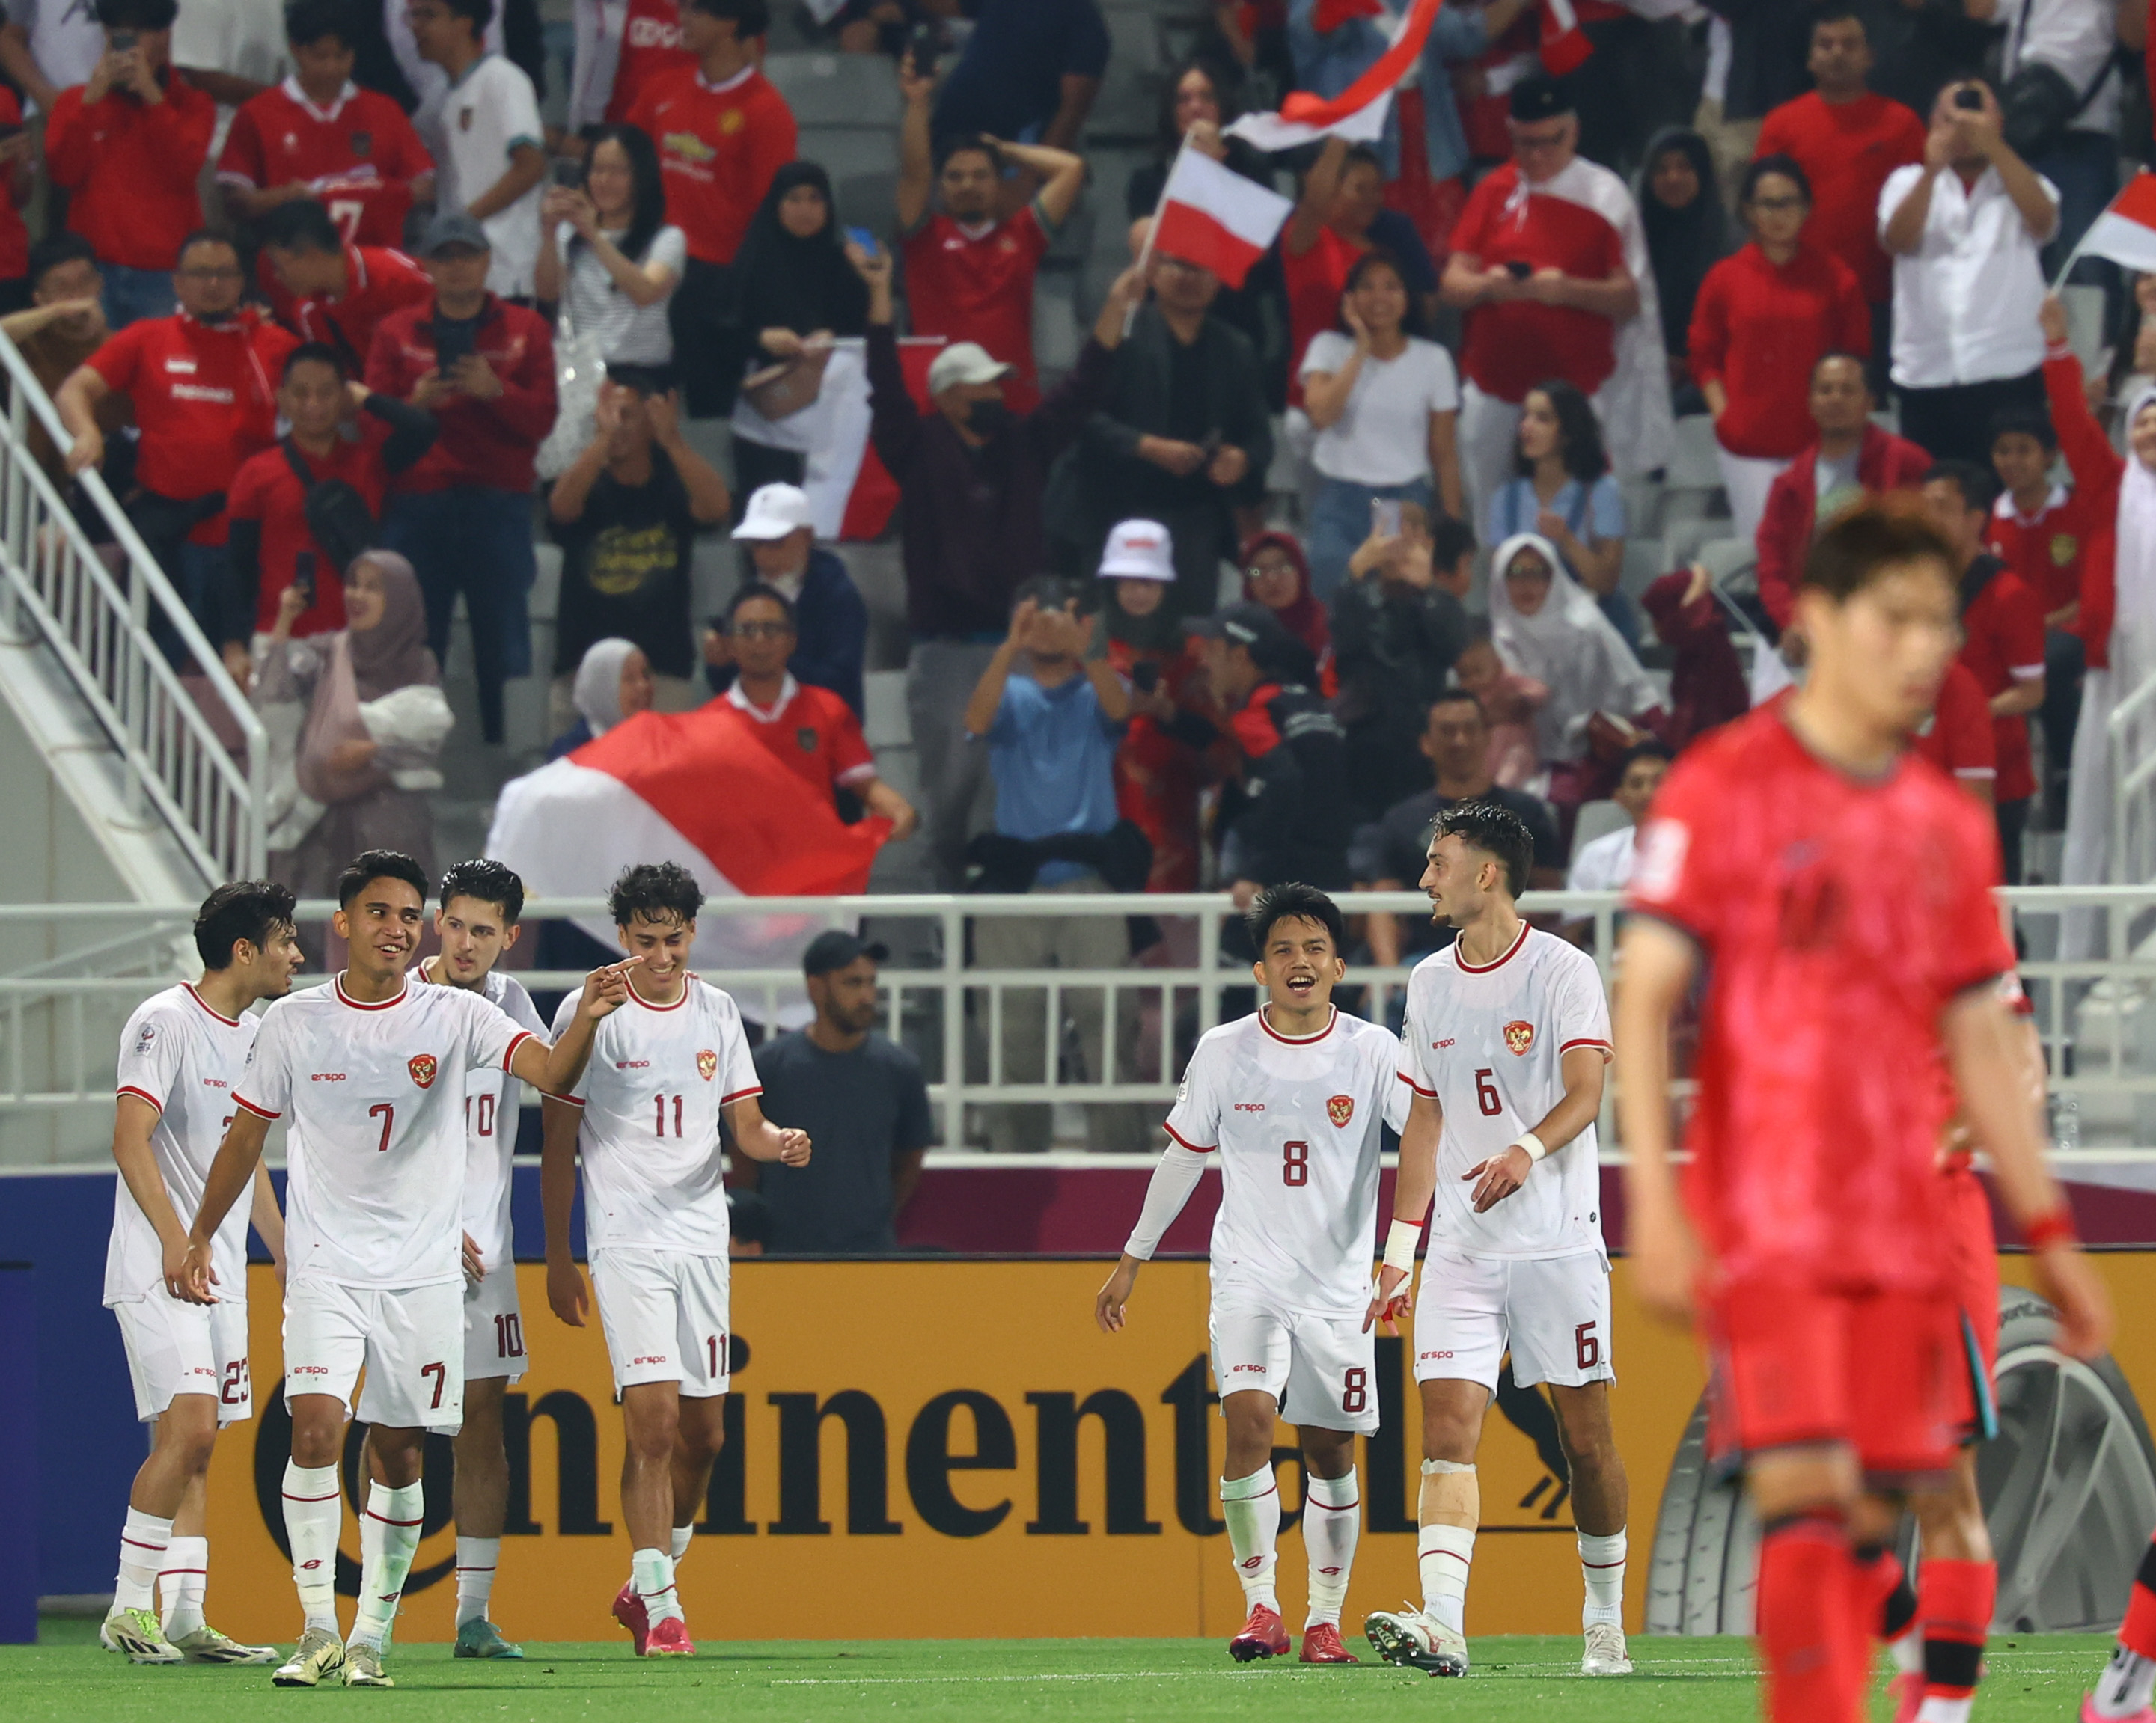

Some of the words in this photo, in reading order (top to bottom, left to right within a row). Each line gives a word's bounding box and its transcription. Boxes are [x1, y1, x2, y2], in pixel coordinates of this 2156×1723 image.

[1432, 1038, 1455, 1050] erspo
[203, 1077, 227, 1089] erspo
[311, 1072, 346, 1083] erspo
[1474, 1068, 1503, 1116] 6
[368, 1102, 394, 1152] 7
[654, 1093, 683, 1138] 11
[1234, 1103, 1265, 1113] erspo
[1283, 1140, 1309, 1187] 8
[495, 1312, 523, 1358] 10
[706, 1333, 727, 1378] 11
[1420, 1350, 1453, 1360] erspo
[1575, 1320, 1598, 1370] 6
[293, 1366, 328, 1375] erspo
[633, 1356, 666, 1365] erspo
[1233, 1364, 1267, 1374] erspo
[421, 1361, 446, 1410] 7
[1342, 1367, 1367, 1413] 8
